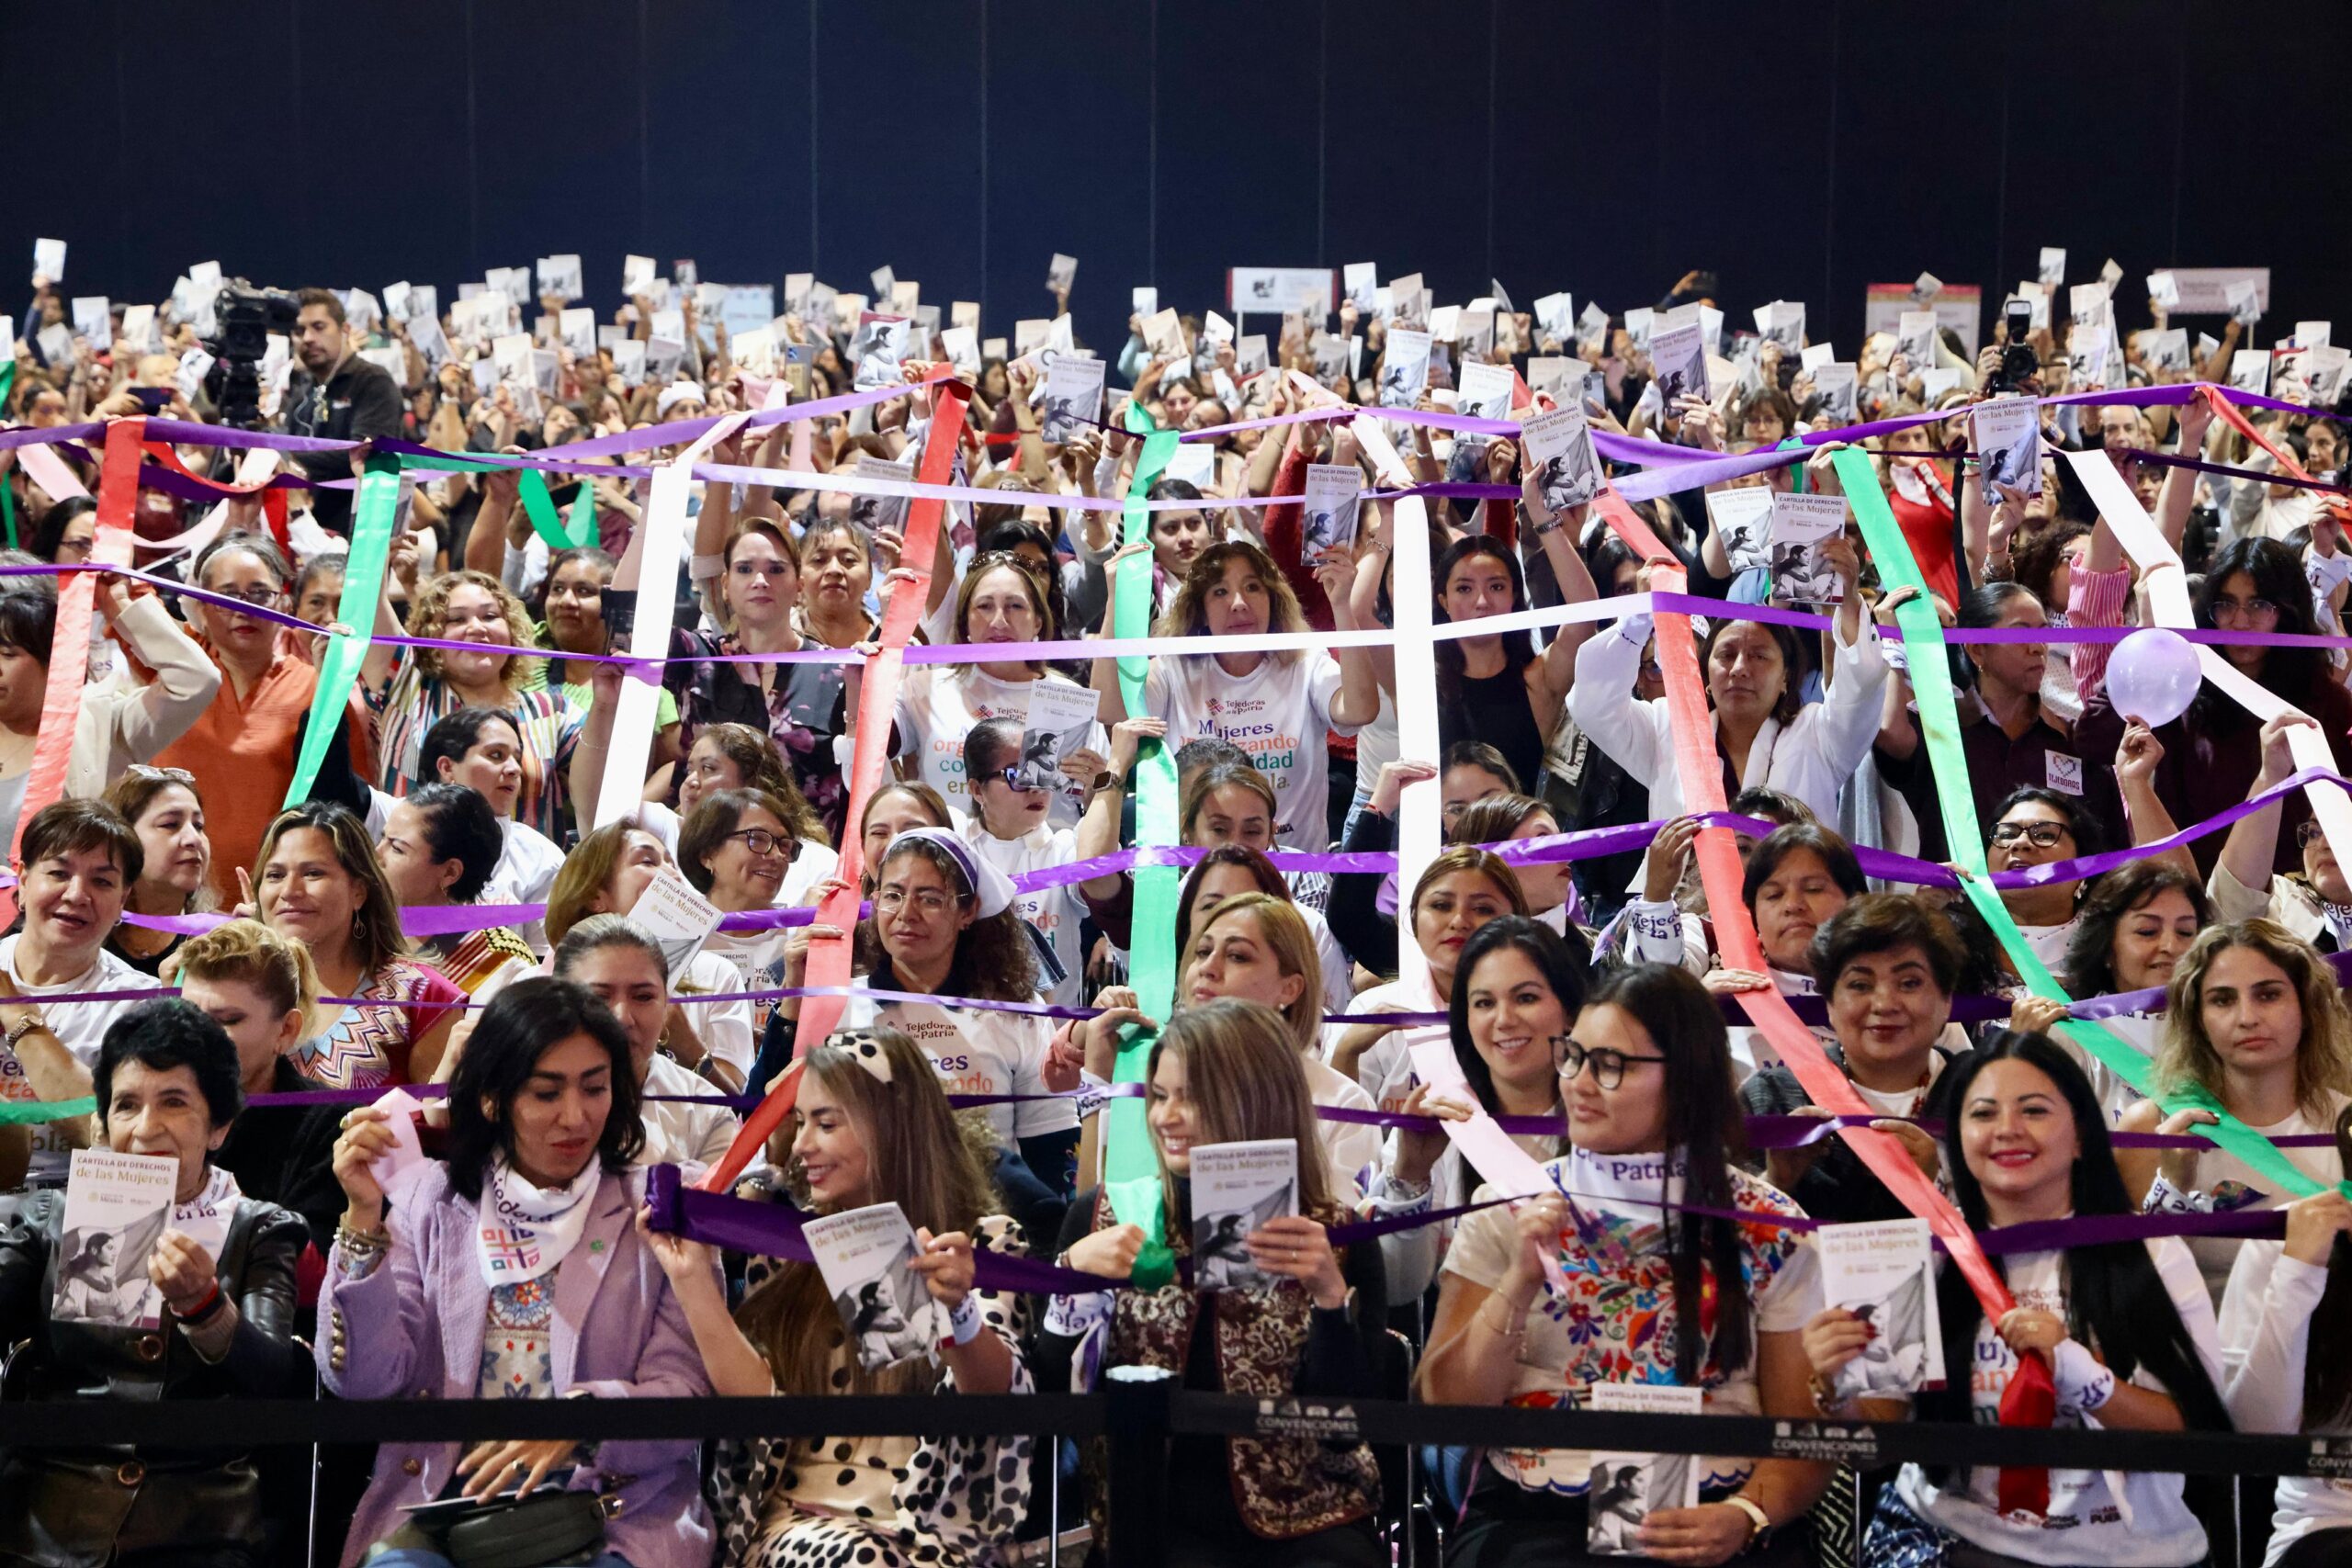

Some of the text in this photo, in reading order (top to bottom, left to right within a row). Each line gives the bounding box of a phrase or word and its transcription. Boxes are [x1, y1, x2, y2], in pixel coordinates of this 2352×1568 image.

[1792, 504, 1804, 513] las
[1806, 505, 1841, 515] Mujeres
[1036, 683, 1060, 694] CARTILLA
[1047, 692, 1059, 700] las
[1061, 695, 1094, 707] Mujeres
[1226, 699, 1265, 709] Tejedoras
[1237, 705, 1263, 715] Patria
[1198, 719, 1274, 741] Mujeres
[2049, 773, 2080, 790] TEJEDORAS
[651, 883, 708, 926] de las Mujeres
[657, 876, 681, 895] CARTILLA
[687, 896, 714, 918] DERECHOS
[906, 1021, 957, 1032] Tejedoras
[921, 1030, 955, 1039] Patria
[77, 1156, 172, 1172] CARTILLA DE DERECHOS
[75, 1167, 169, 1186] de las Mujeres
